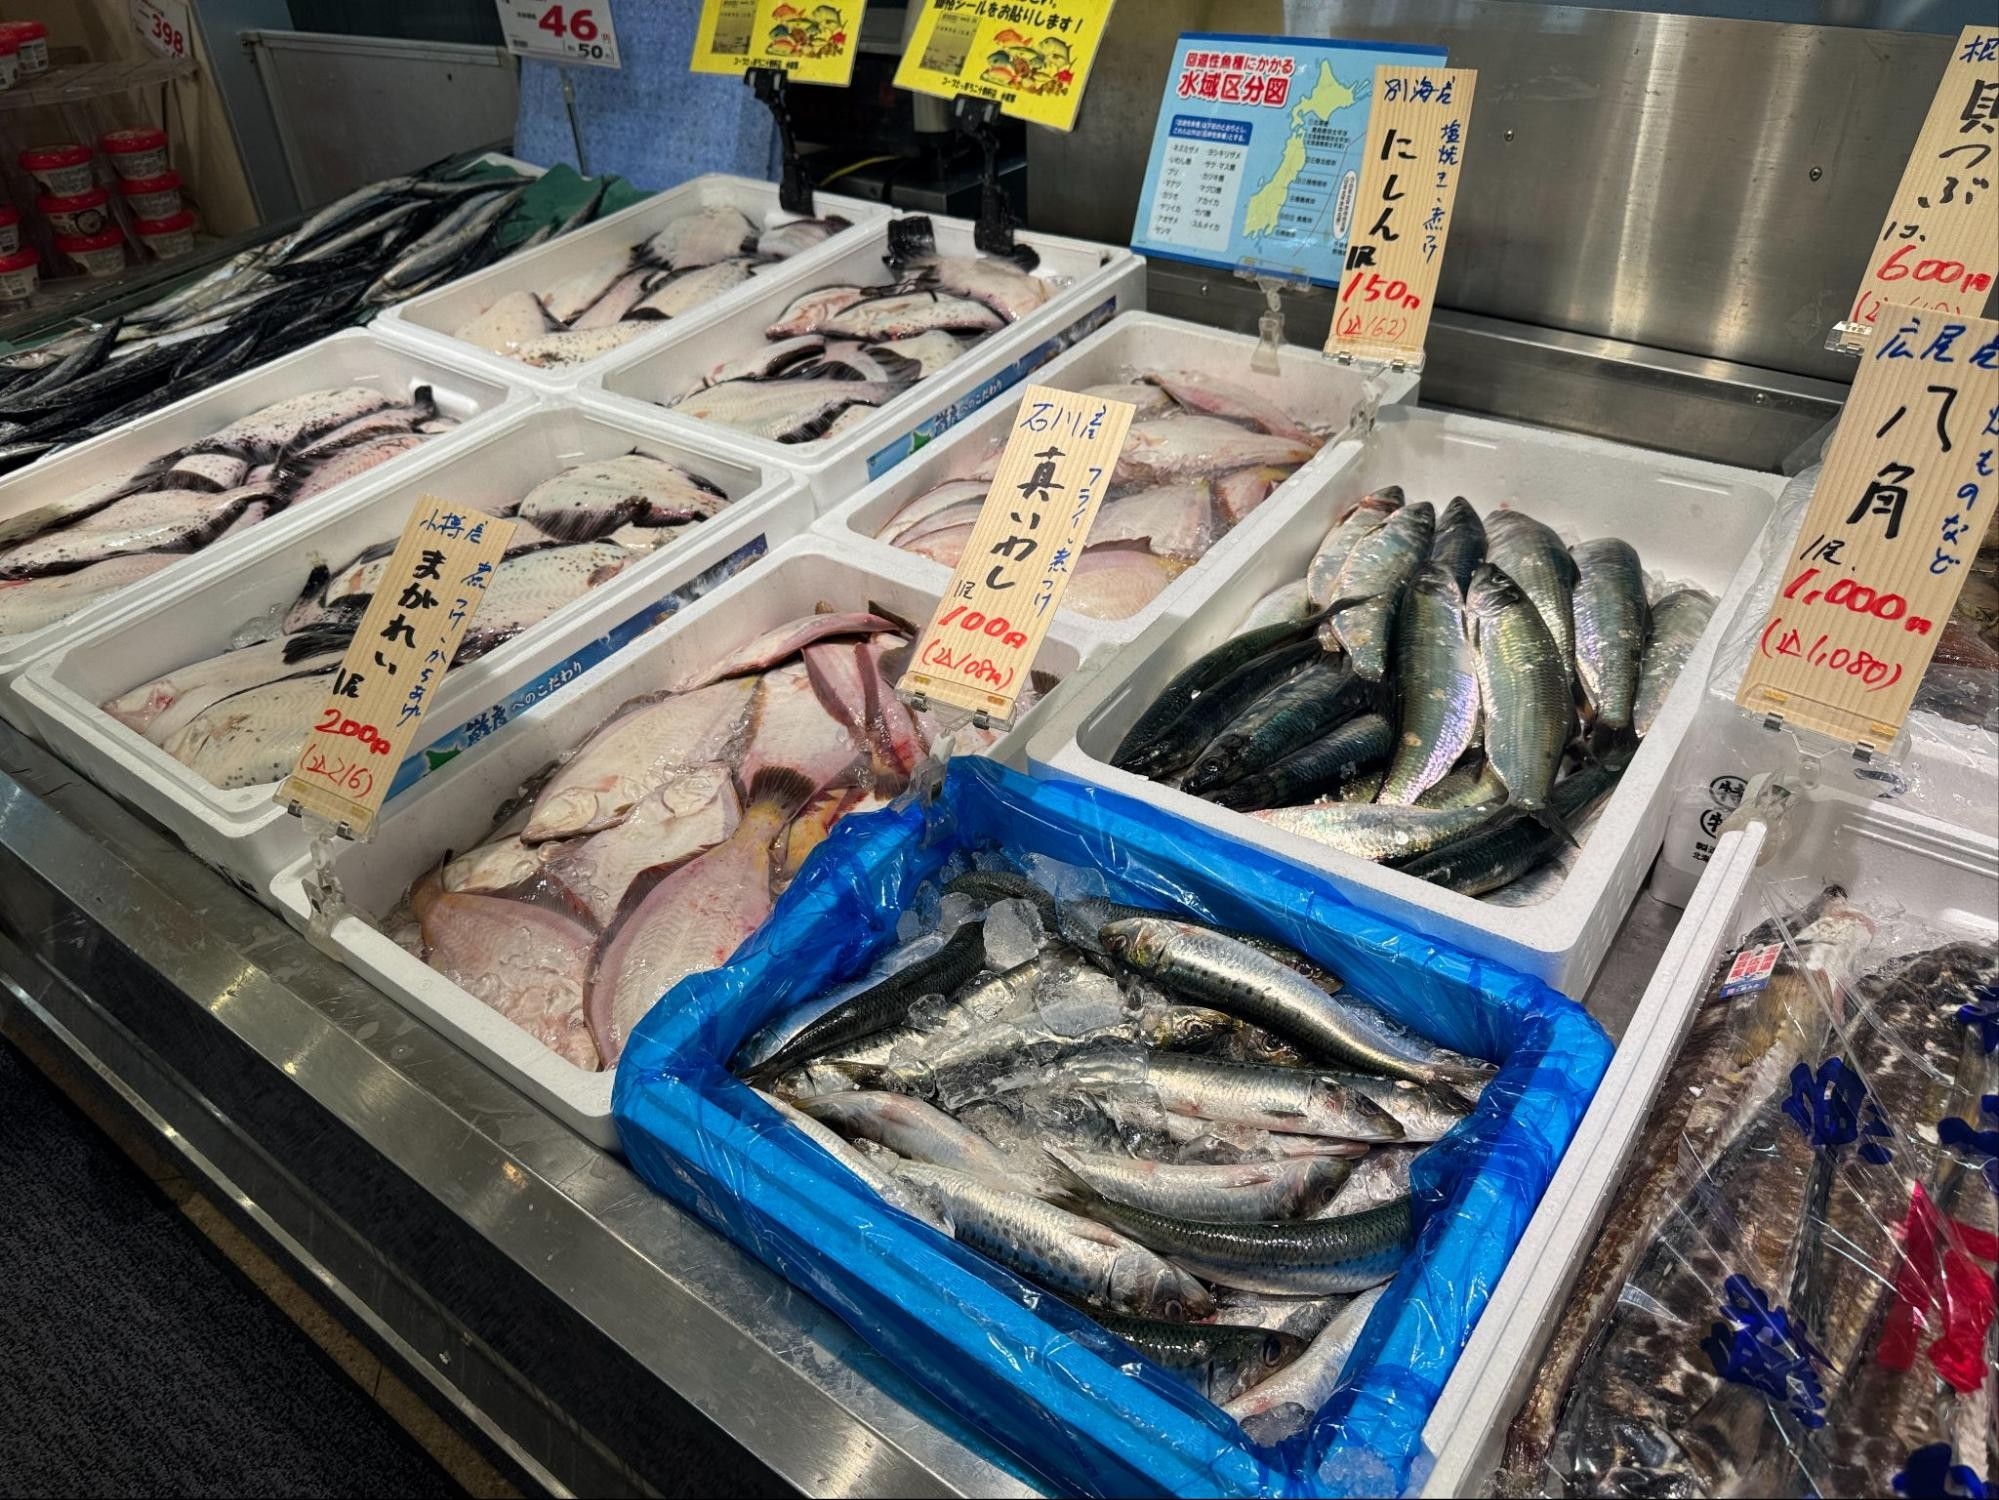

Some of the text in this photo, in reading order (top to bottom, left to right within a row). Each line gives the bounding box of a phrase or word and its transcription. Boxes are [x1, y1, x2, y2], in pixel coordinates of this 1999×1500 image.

[152, 13, 184, 55] 398
[538, 4, 599, 42] 46
[579, 43, 603, 59] 50
[1185, 51, 1294, 74] 回遊性魚種にかかる
[1178, 69, 1290, 105] 水域区分図
[1368, 128, 1418, 242] にしん
[1846, 384, 1959, 540] 八角
[985, 446, 1067, 590] 真いわし
[374, 549, 447, 675] まがれい
